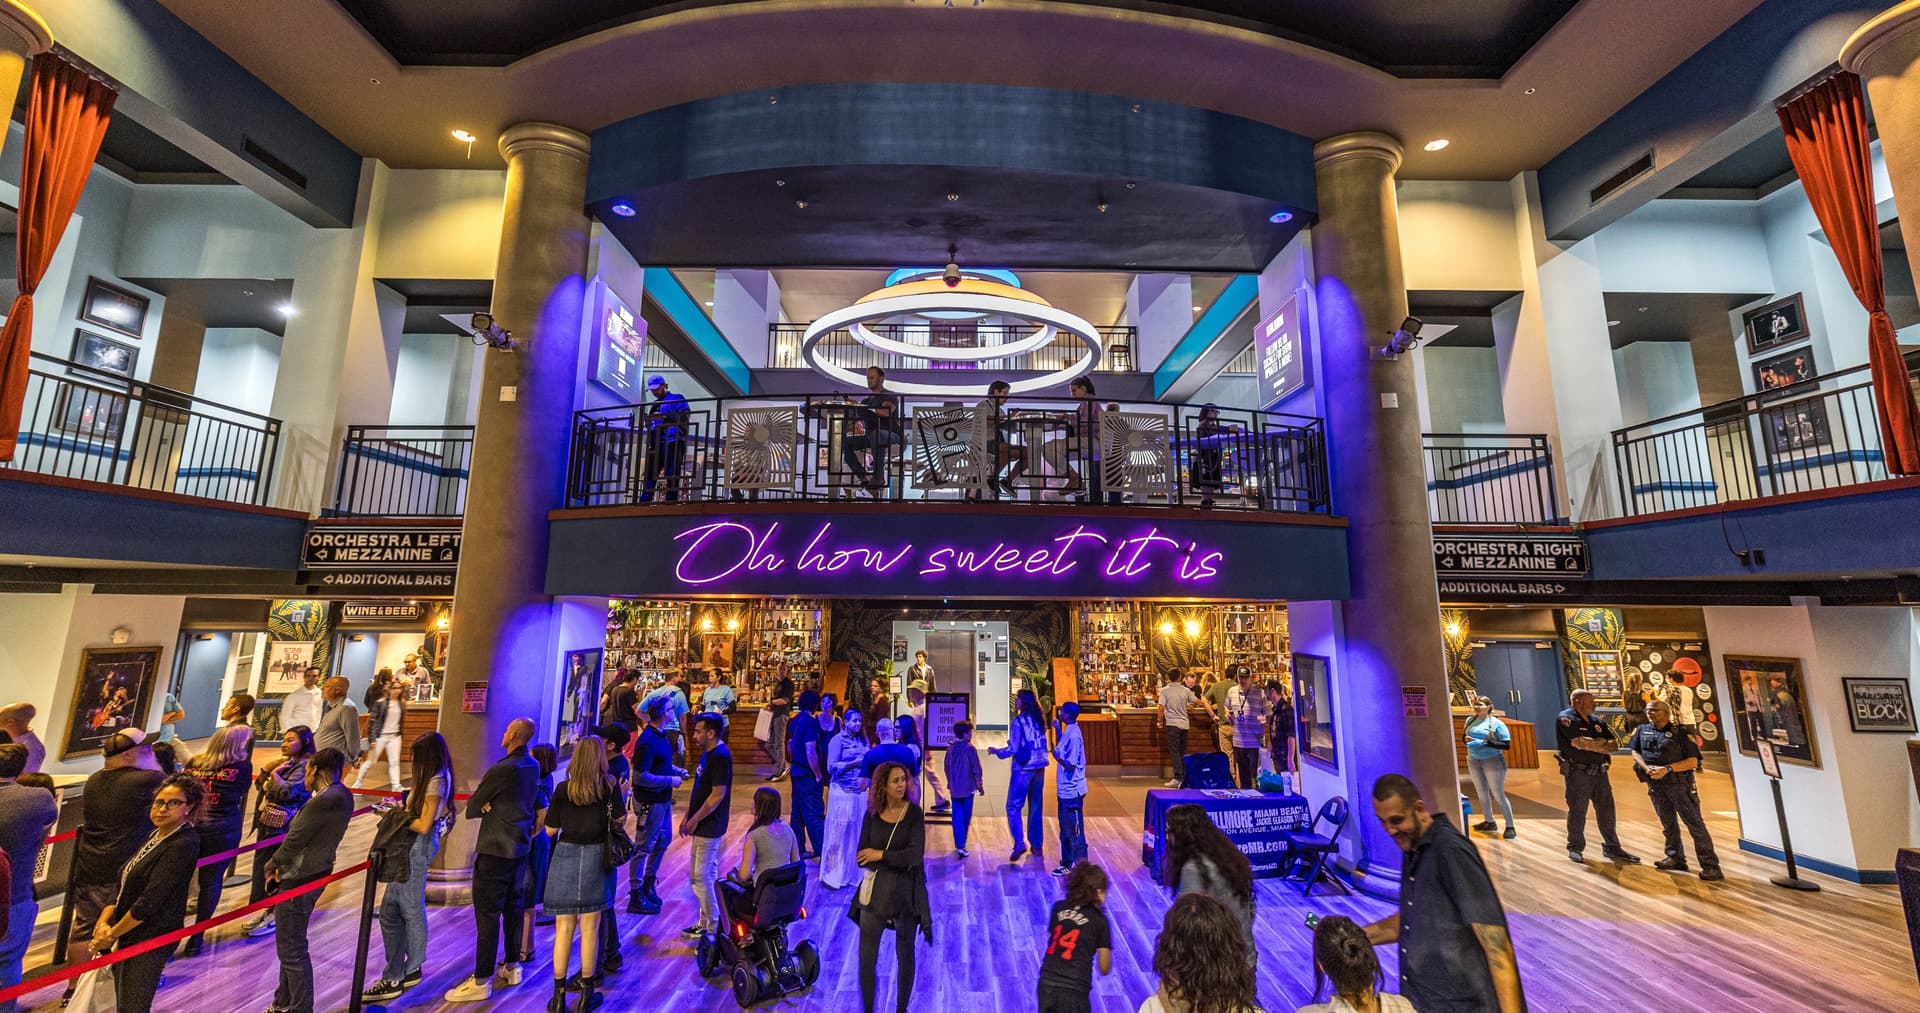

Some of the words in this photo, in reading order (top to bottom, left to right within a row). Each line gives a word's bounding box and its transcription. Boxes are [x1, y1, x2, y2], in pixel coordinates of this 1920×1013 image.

[309, 534, 412, 547] ORCHESTRA
[417, 534, 461, 547] LEFT
[334, 548, 433, 561] MEZZANINE
[673, 521, 785, 584] Oh
[796, 521, 913, 572] how
[919, 524, 1108, 576] sweet
[1106, 527, 1180, 577] it
[1180, 541, 1224, 581] is
[1433, 542, 1530, 556] ORCHESTRA
[1533, 543, 1582, 556] RIGHT
[1461, 556, 1557, 569] MEZZANINE
[334, 573, 414, 585] ADDITIONAL
[415, 574, 452, 586] BARS
[1440, 581, 1517, 593] ADDITIONAL
[1518, 583, 1554, 594] BARS
[346, 606, 417, 617] WINE&BEER
[1856, 704, 1908, 719] BLOCK
[939, 716, 955, 724] OPEN
[1254, 808, 1279, 818] MIAMI
[1256, 817, 1272, 826] JACKIE
[1272, 815, 1295, 825] GLEASON
[1045, 924, 1081, 961] 14
